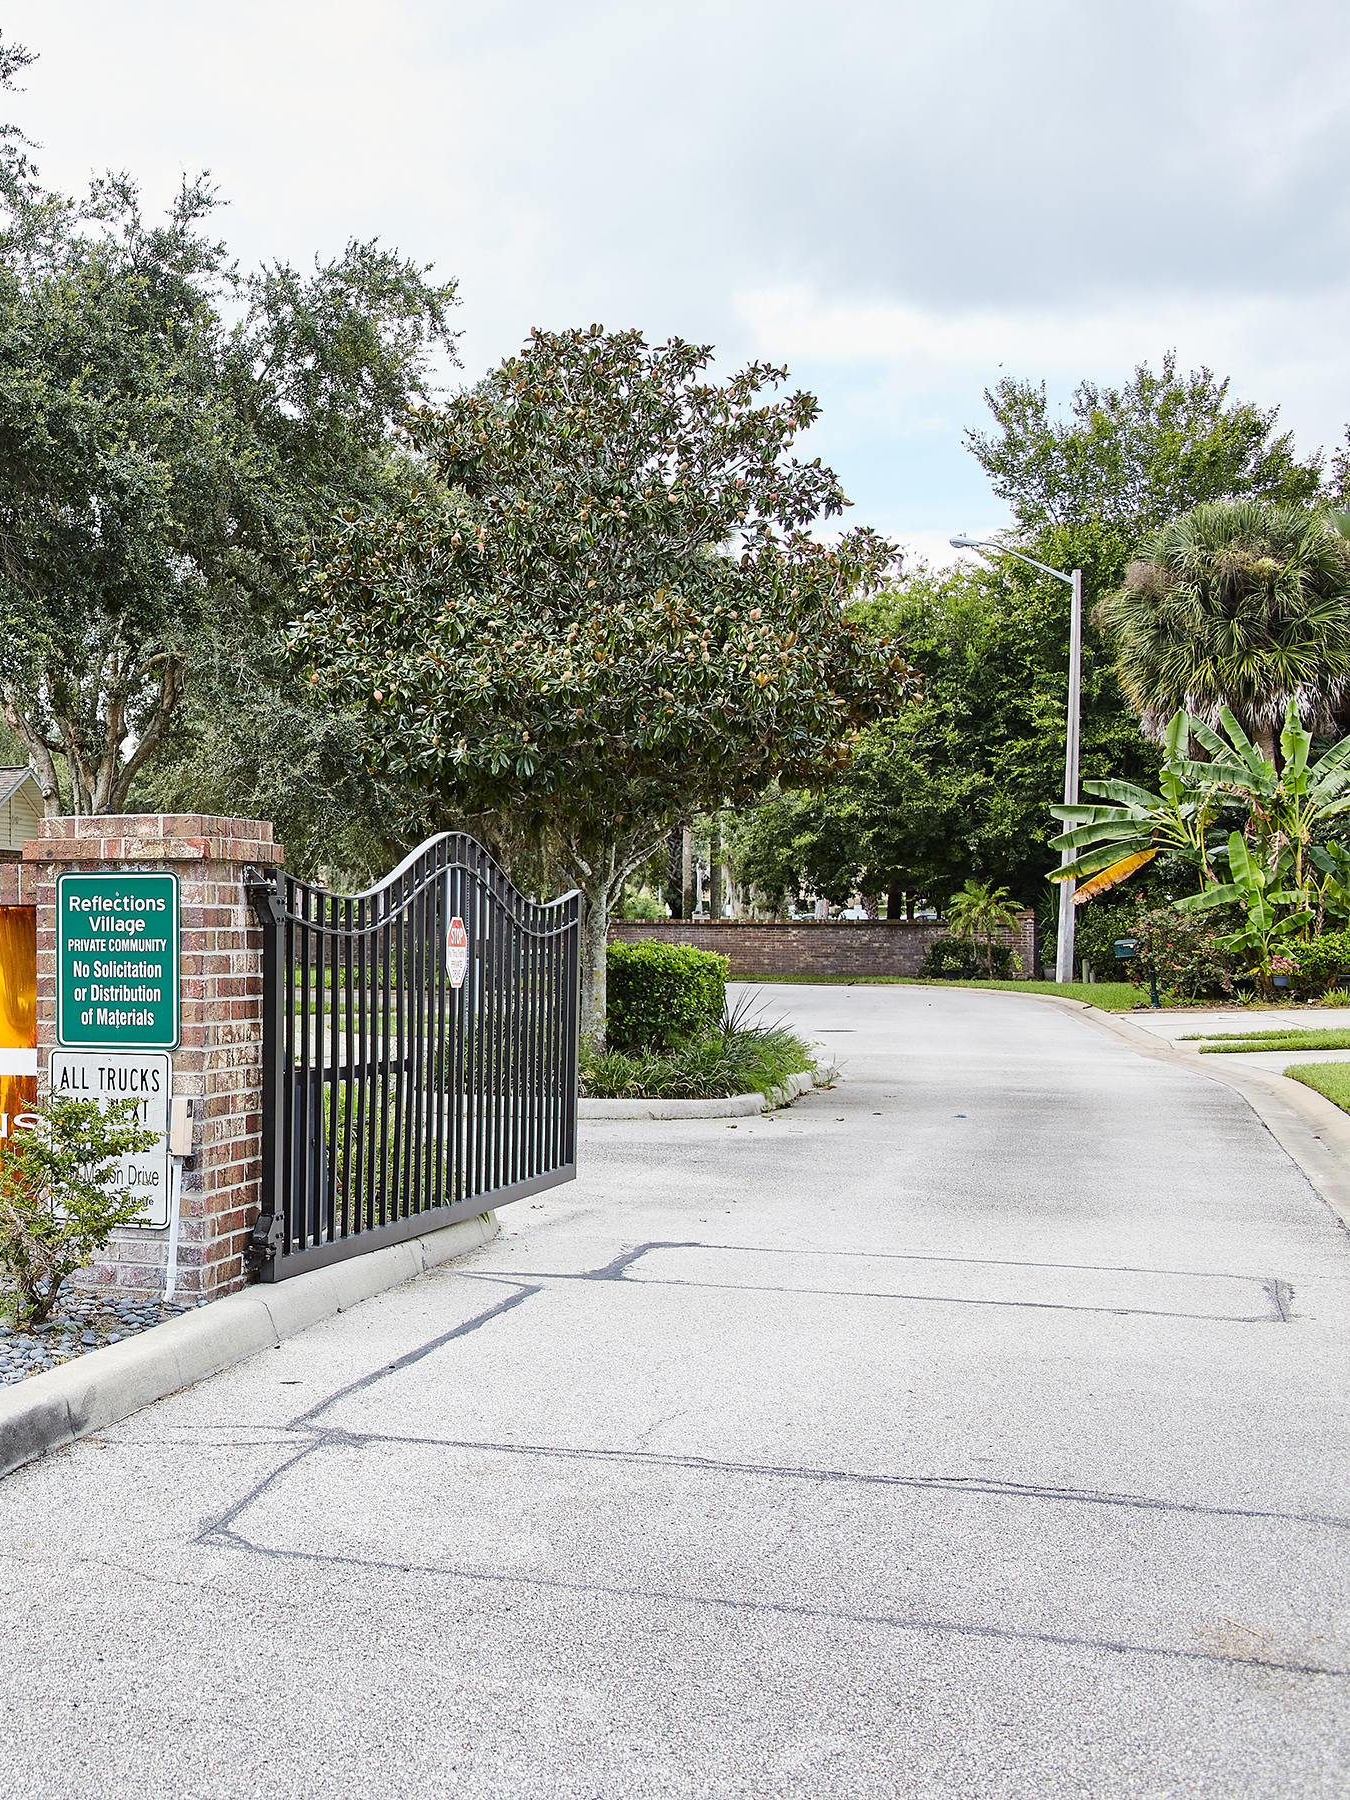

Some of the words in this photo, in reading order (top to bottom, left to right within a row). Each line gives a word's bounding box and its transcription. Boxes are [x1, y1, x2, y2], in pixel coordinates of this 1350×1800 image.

[69, 895, 166, 912] Reflections
[88, 916, 146, 936] Village
[68, 939, 106, 952] PRIVATE
[108, 939, 167, 952] COMMUNITY
[73, 960, 90, 978] No
[93, 960, 162, 978] Solicitation
[74, 987, 87, 1002] or
[90, 984, 161, 1002] Distribution
[81, 1008, 93, 1025] of
[96, 1008, 154, 1026] Materials
[60, 1066, 89, 1089] ALL
[98, 1068, 160, 1092] TRUCKS
[128, 1165, 159, 1186] Drive
